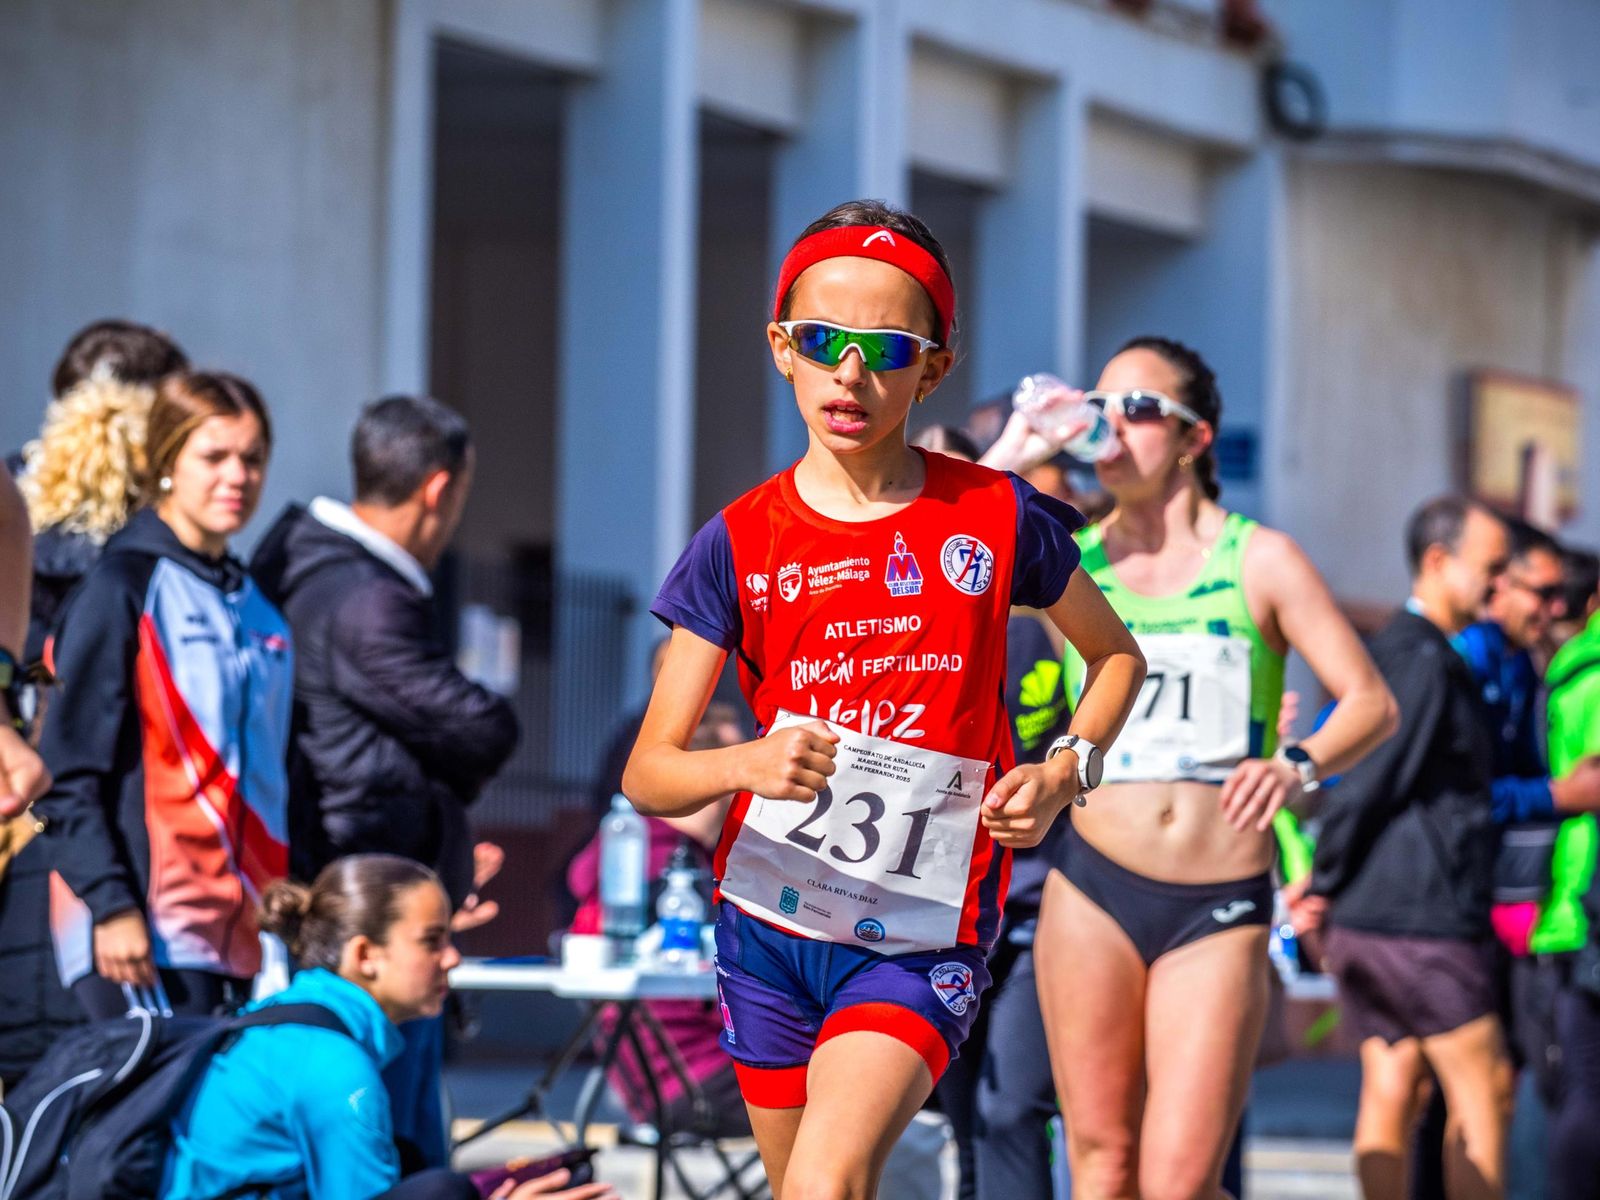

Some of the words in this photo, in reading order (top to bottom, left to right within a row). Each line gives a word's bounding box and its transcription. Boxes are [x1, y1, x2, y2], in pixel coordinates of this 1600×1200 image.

[808, 557, 870, 577] Ayuntamiento
[808, 569, 870, 588] Vélez-Málaga
[892, 585, 920, 595] DELSUR
[824, 615, 922, 640] ATLETISMO
[862, 653, 963, 677] FERTILIDAD
[843, 744, 884, 760] CAMPEONATO
[893, 757, 926, 769] ANDALUCÍA
[857, 757, 882, 768] MARCHA
[893, 764, 908, 774] RUTA
[850, 763, 864, 772] SAN
[864, 764, 895, 779] FERNANDO
[895, 774, 911, 783] 2025
[785, 783, 932, 880] 231
[807, 878, 832, 893] CLARA
[834, 887, 858, 900] RIVAS
[858, 894, 879, 905] DIAZ
